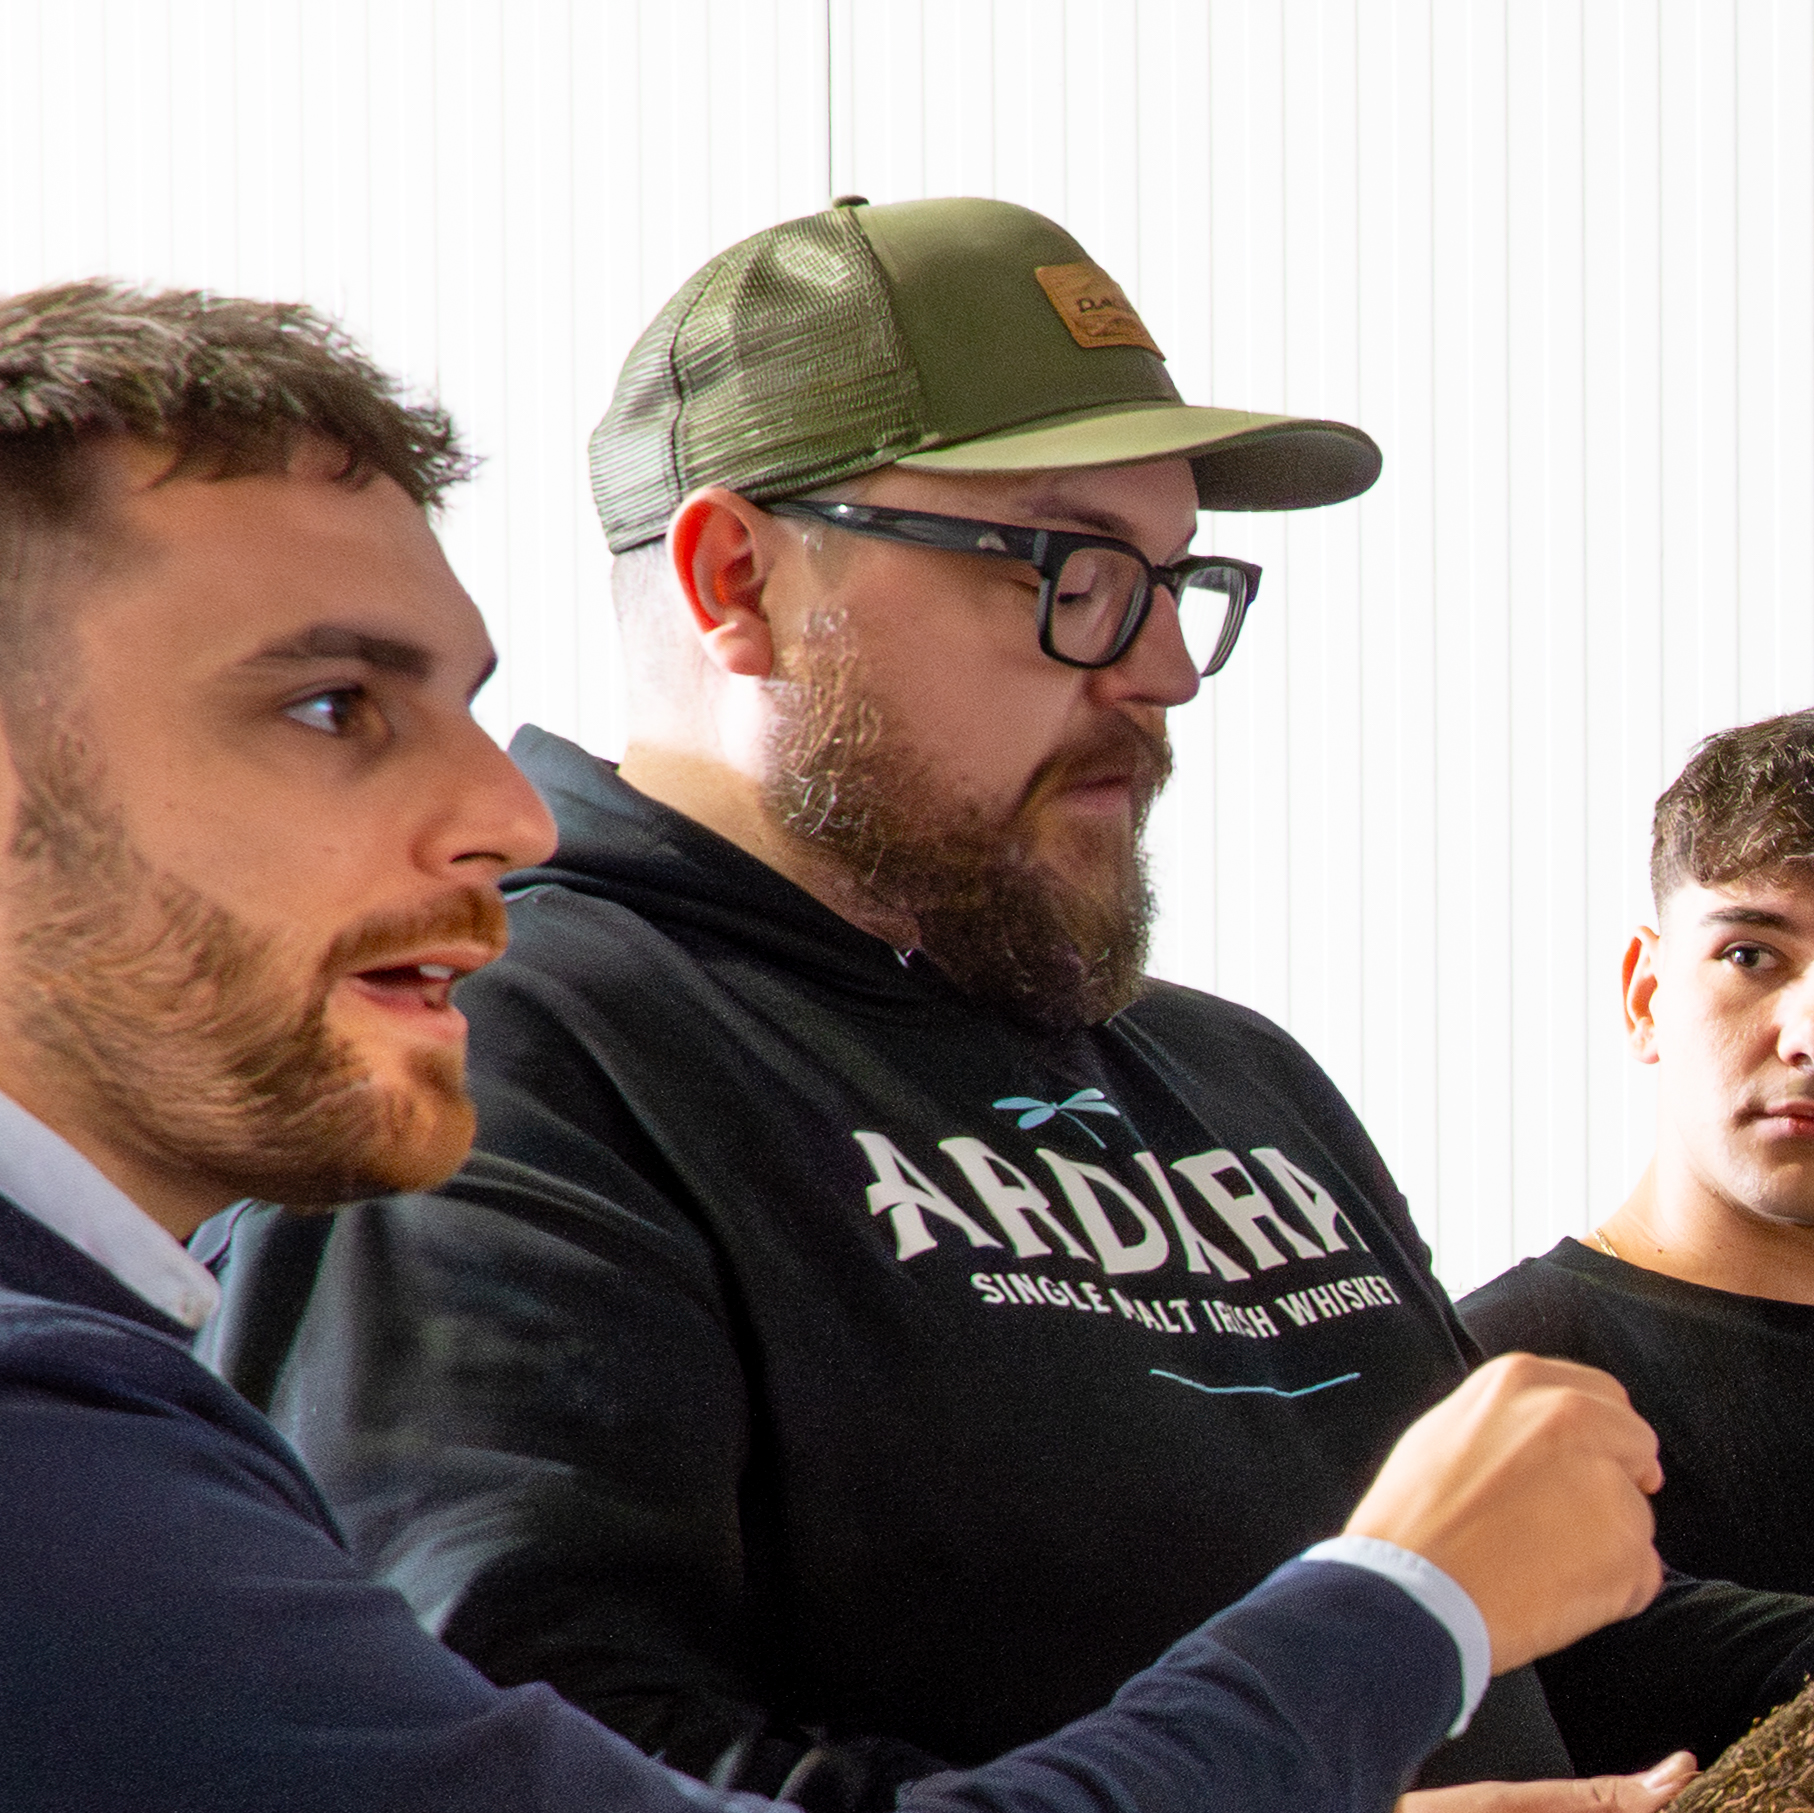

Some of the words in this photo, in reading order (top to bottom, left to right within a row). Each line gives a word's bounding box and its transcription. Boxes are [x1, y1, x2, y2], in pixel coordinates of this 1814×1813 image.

[969, 1271, 1112, 1314] SINGLE
[1110, 1288, 1197, 1334] MALT
[1201, 1298, 1281, 1340] IRISH
[1276, 1275, 1402, 1327] WHISKEY
